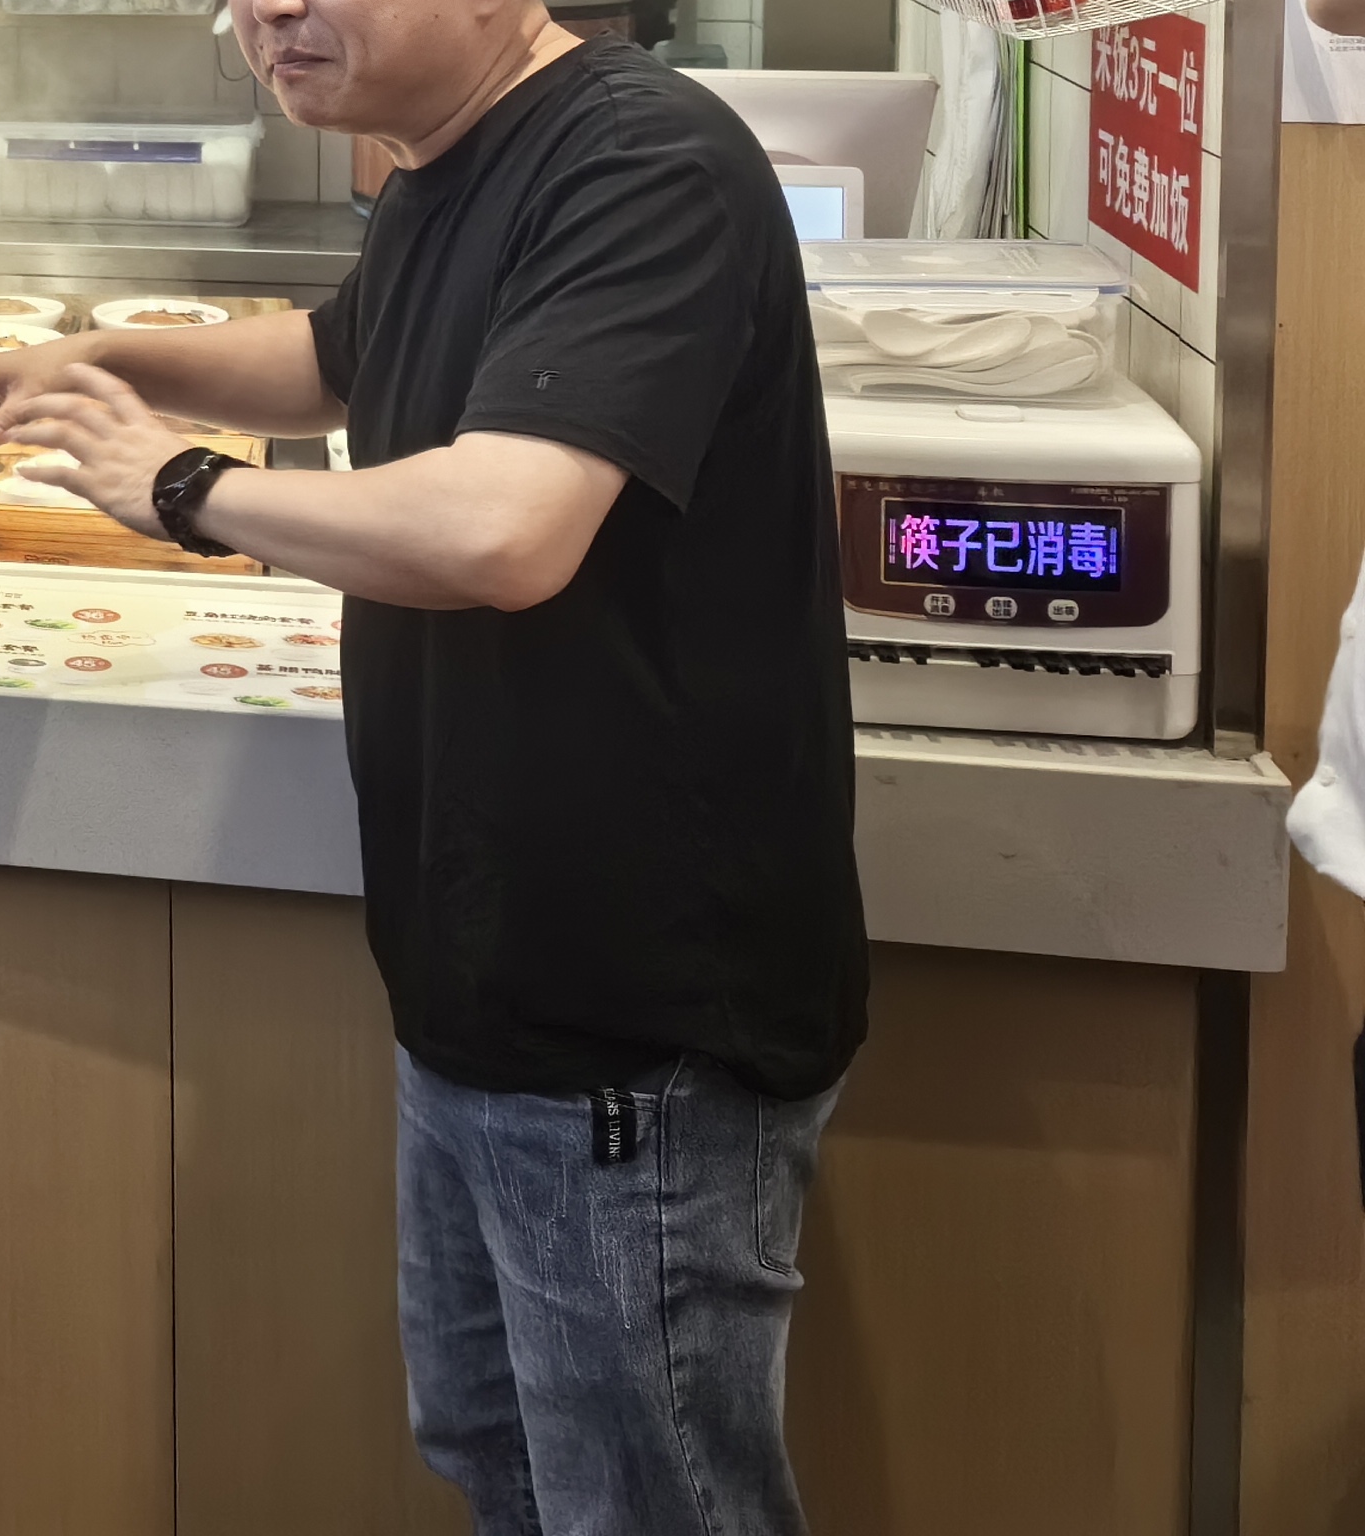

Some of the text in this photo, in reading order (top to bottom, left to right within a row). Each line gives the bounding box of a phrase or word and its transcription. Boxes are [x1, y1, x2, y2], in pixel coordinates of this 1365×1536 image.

[1098, 128, 1191, 255] 可免费加饭
[900, 514, 1108, 578] 筷子已消毒
